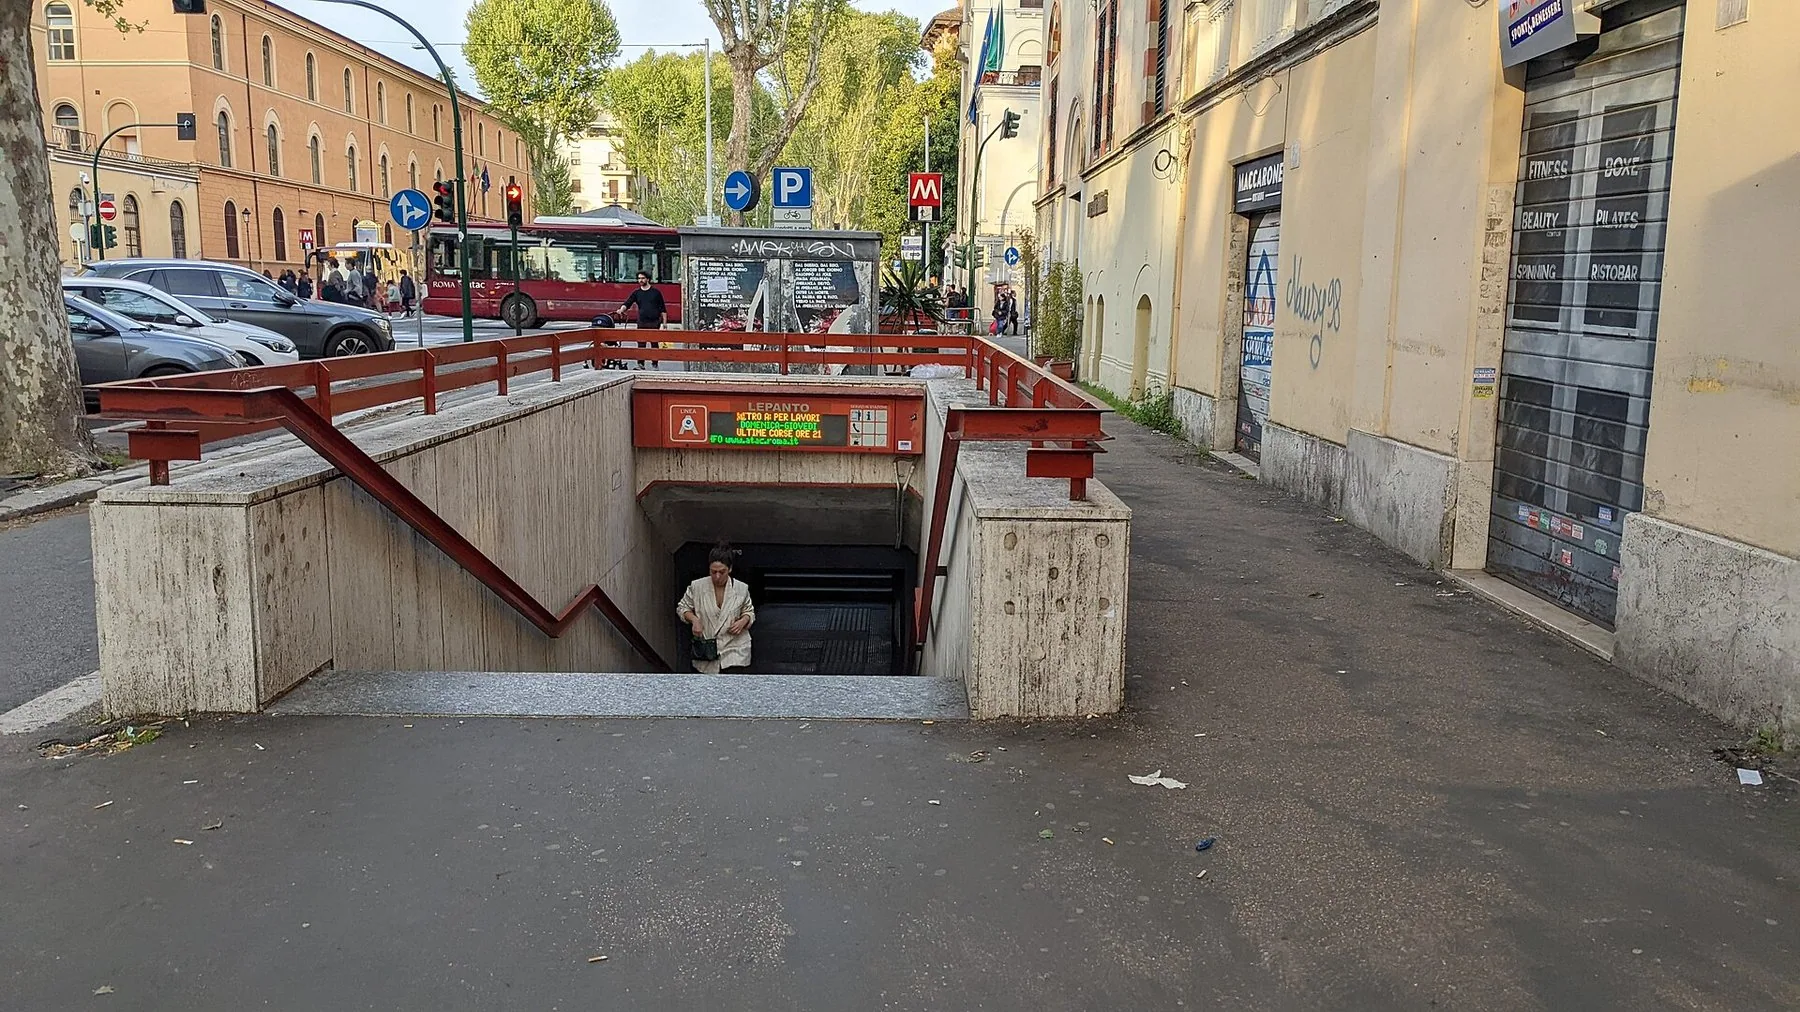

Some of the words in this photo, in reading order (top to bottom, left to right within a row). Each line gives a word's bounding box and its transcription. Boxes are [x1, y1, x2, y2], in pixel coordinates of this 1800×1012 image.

[1528, 160, 1568, 179] FITNESS
[1604, 157, 1640, 178] BOXE
[1238, 162, 1283, 192] MACCARONE
[780, 172, 803, 202] P
[912, 179, 938, 200] M
[1522, 212, 1559, 230] BEAUTY
[1596, 210, 1638, 228] PILATES
[1517, 264, 1556, 280] SPINNING
[1591, 264, 1638, 280] RISTOBAR
[748, 402, 810, 412] LEPANTO
[725, 437, 799, 445] www.atac.roma.it
[737, 429, 767, 437] ULTIME
[769, 429, 792, 437] CORSE
